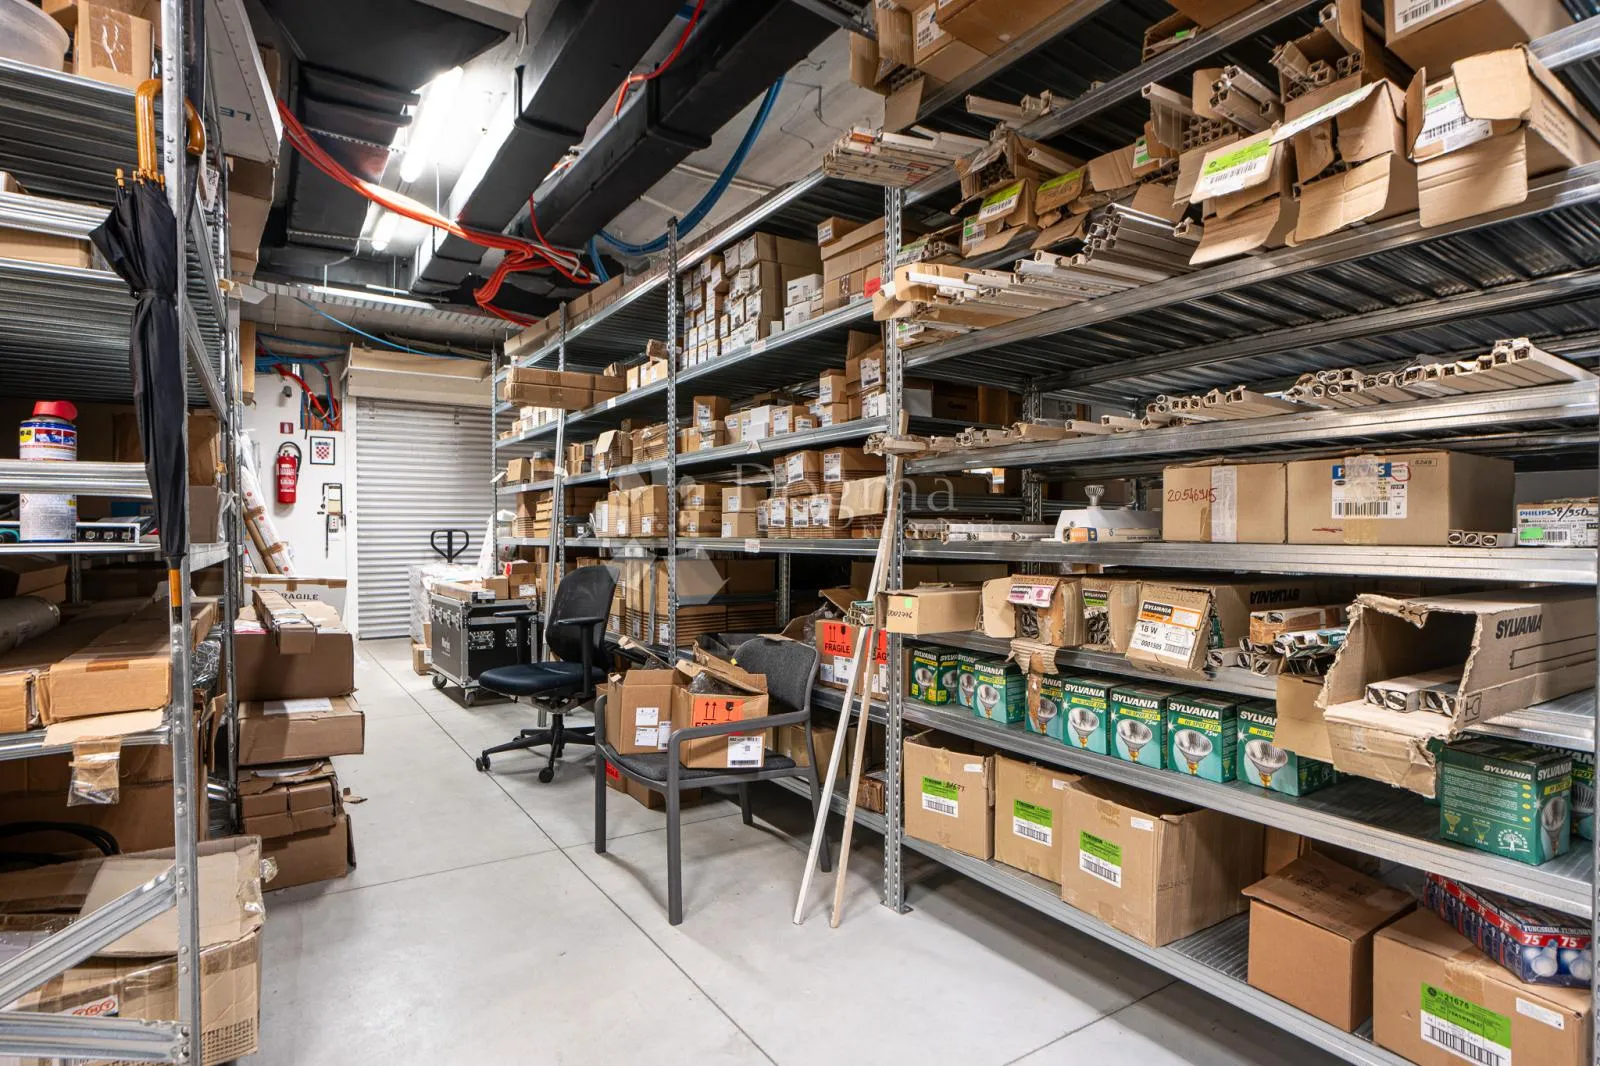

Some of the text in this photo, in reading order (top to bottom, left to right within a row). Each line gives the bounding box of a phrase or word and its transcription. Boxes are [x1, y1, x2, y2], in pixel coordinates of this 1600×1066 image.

[281, 592, 319, 601] RAGILE
[1250, 588, 1300, 605] SYLVANIA
[1143, 604, 1172, 615] SYLVANIA
[1140, 624, 1159, 635] 18 W
[1495, 614, 1543, 640] SYLVANIA
[824, 642, 851, 654] FRAGILE
[913, 649, 938, 661] SYLVANIA
[974, 663, 1004, 676] SYLVANIA
[1041, 677, 1062, 688] ANIA
[1064, 683, 1105, 698] SYLVANIA
[1112, 693, 1159, 709] SYLVANIA
[1169, 702, 1220, 719] SYLVANIA
[1240, 710, 1277, 726] SYLVA
[1483, 764, 1532, 781] SYLVANIA
[1537, 761, 1572, 781] SYLVANIA
[1499, 919, 1511, 932] 75
[1524, 934, 1578, 947] 75 75
